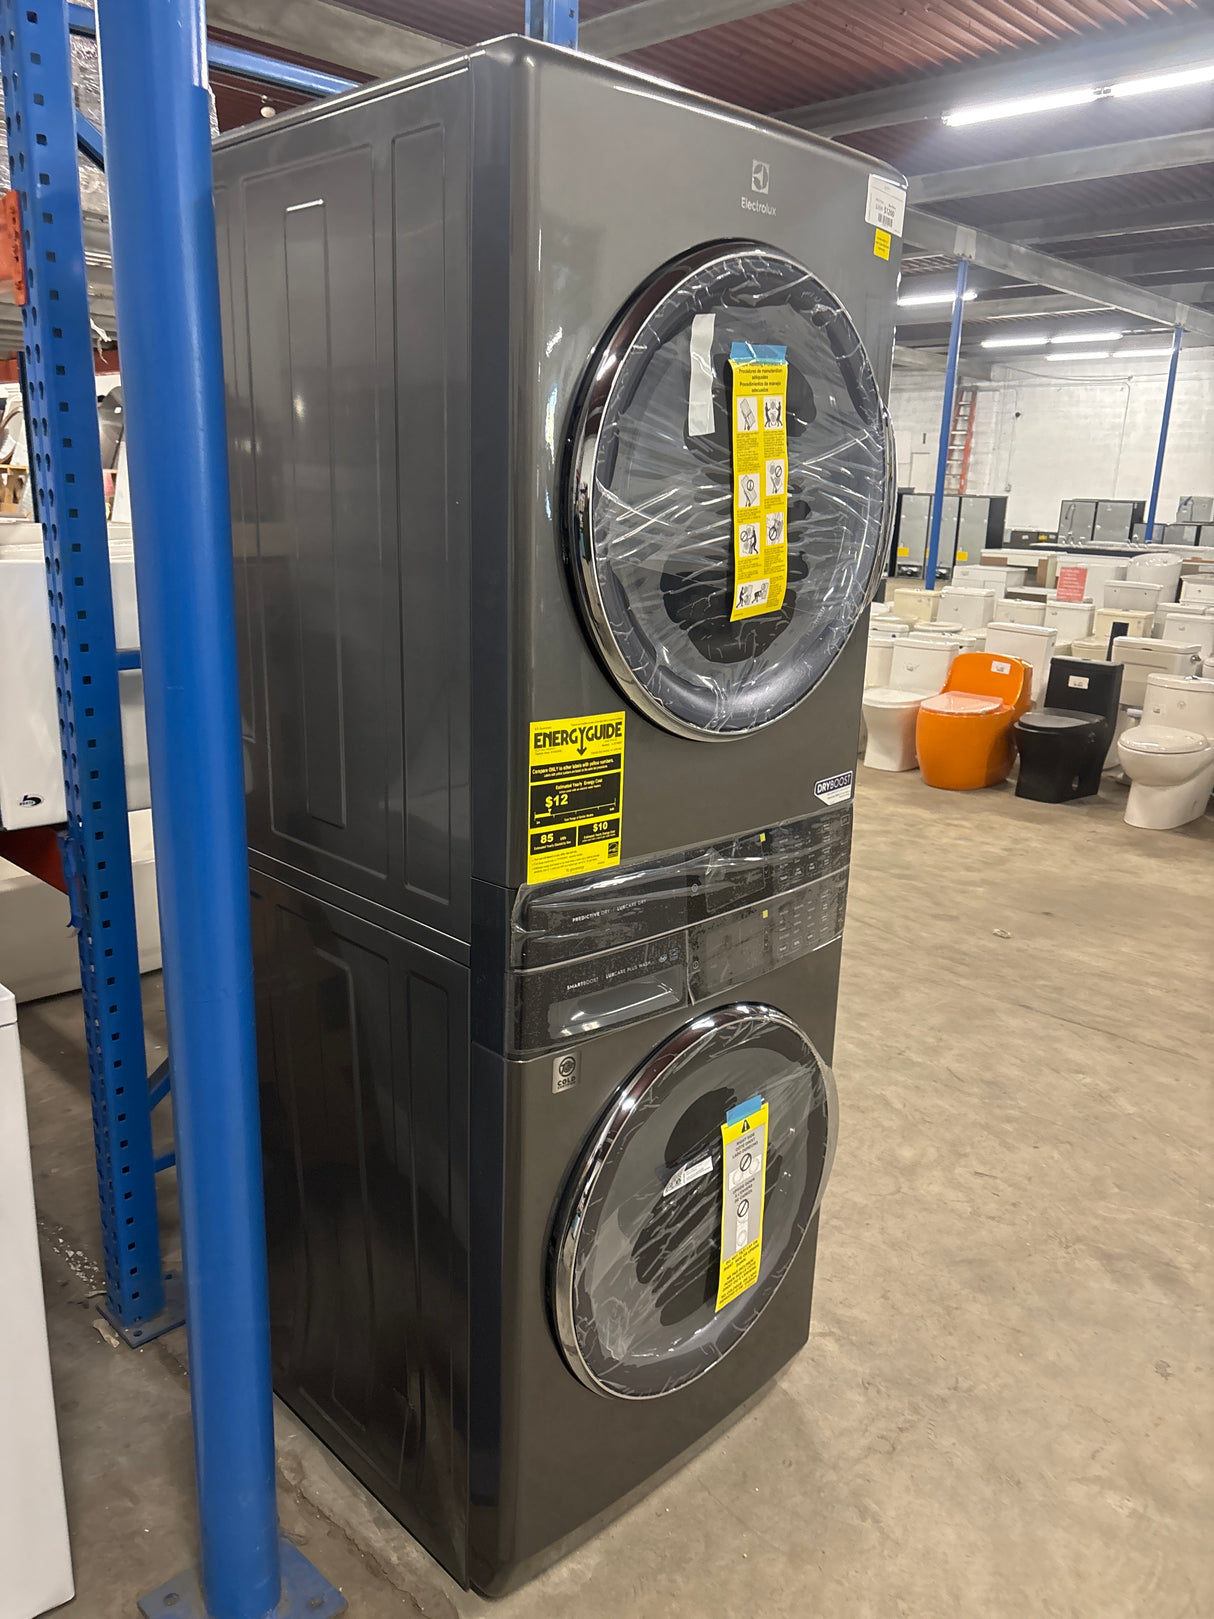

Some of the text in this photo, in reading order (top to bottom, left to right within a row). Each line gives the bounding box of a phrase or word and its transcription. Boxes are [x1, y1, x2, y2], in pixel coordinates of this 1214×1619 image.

[741, 197, 776, 216] Electrolux
[534, 722, 622, 750] ENERGYGUIDE
[817, 774, 850, 793] DRYBOOST
[545, 794, 568, 808] $12
[593, 822, 608, 832] $10
[540, 833, 554, 844] 85
[572, 911, 600, 922] PREDICTIVE
[567, 977, 598, 990] SMARTBOOST
[558, 1076, 576, 1086] COLD
